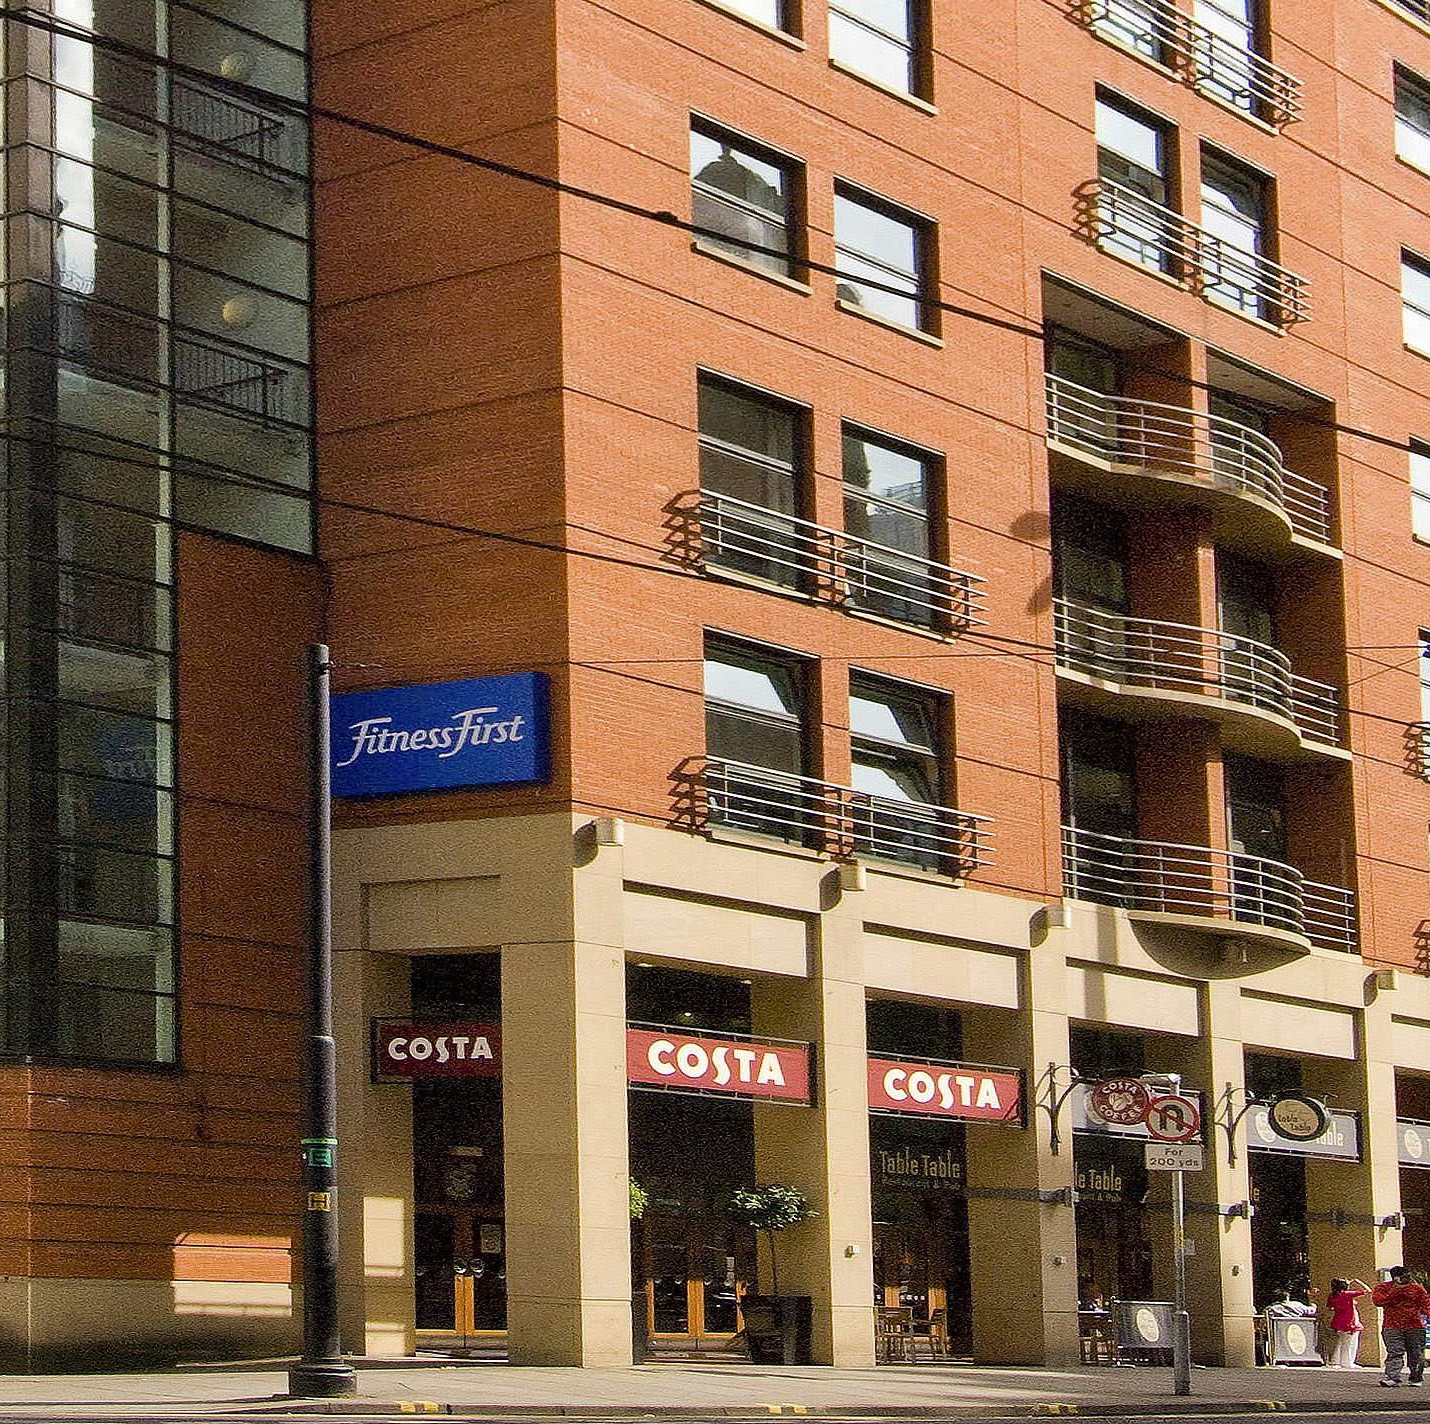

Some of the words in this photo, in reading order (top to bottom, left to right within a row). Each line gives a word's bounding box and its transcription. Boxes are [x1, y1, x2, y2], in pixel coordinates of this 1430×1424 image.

[336, 716, 453, 767] Fitness
[438, 706, 526, 759] First
[388, 1036, 494, 1063] COSTA
[647, 1039, 786, 1086] COSTA
[883, 1068, 1002, 1110] COSTA
[1101, 1081, 1139, 1094] COSTA
[1099, 1104, 1143, 1120] COFFEE
[879, 1146, 919, 1176] Table
[920, 1149, 960, 1178] Table
[1149, 1157, 1176, 1167] 200
[1178, 1157, 1200, 1168] yds
[1164, 1147, 1184, 1157] For
[1088, 1164, 1122, 1192] Table
